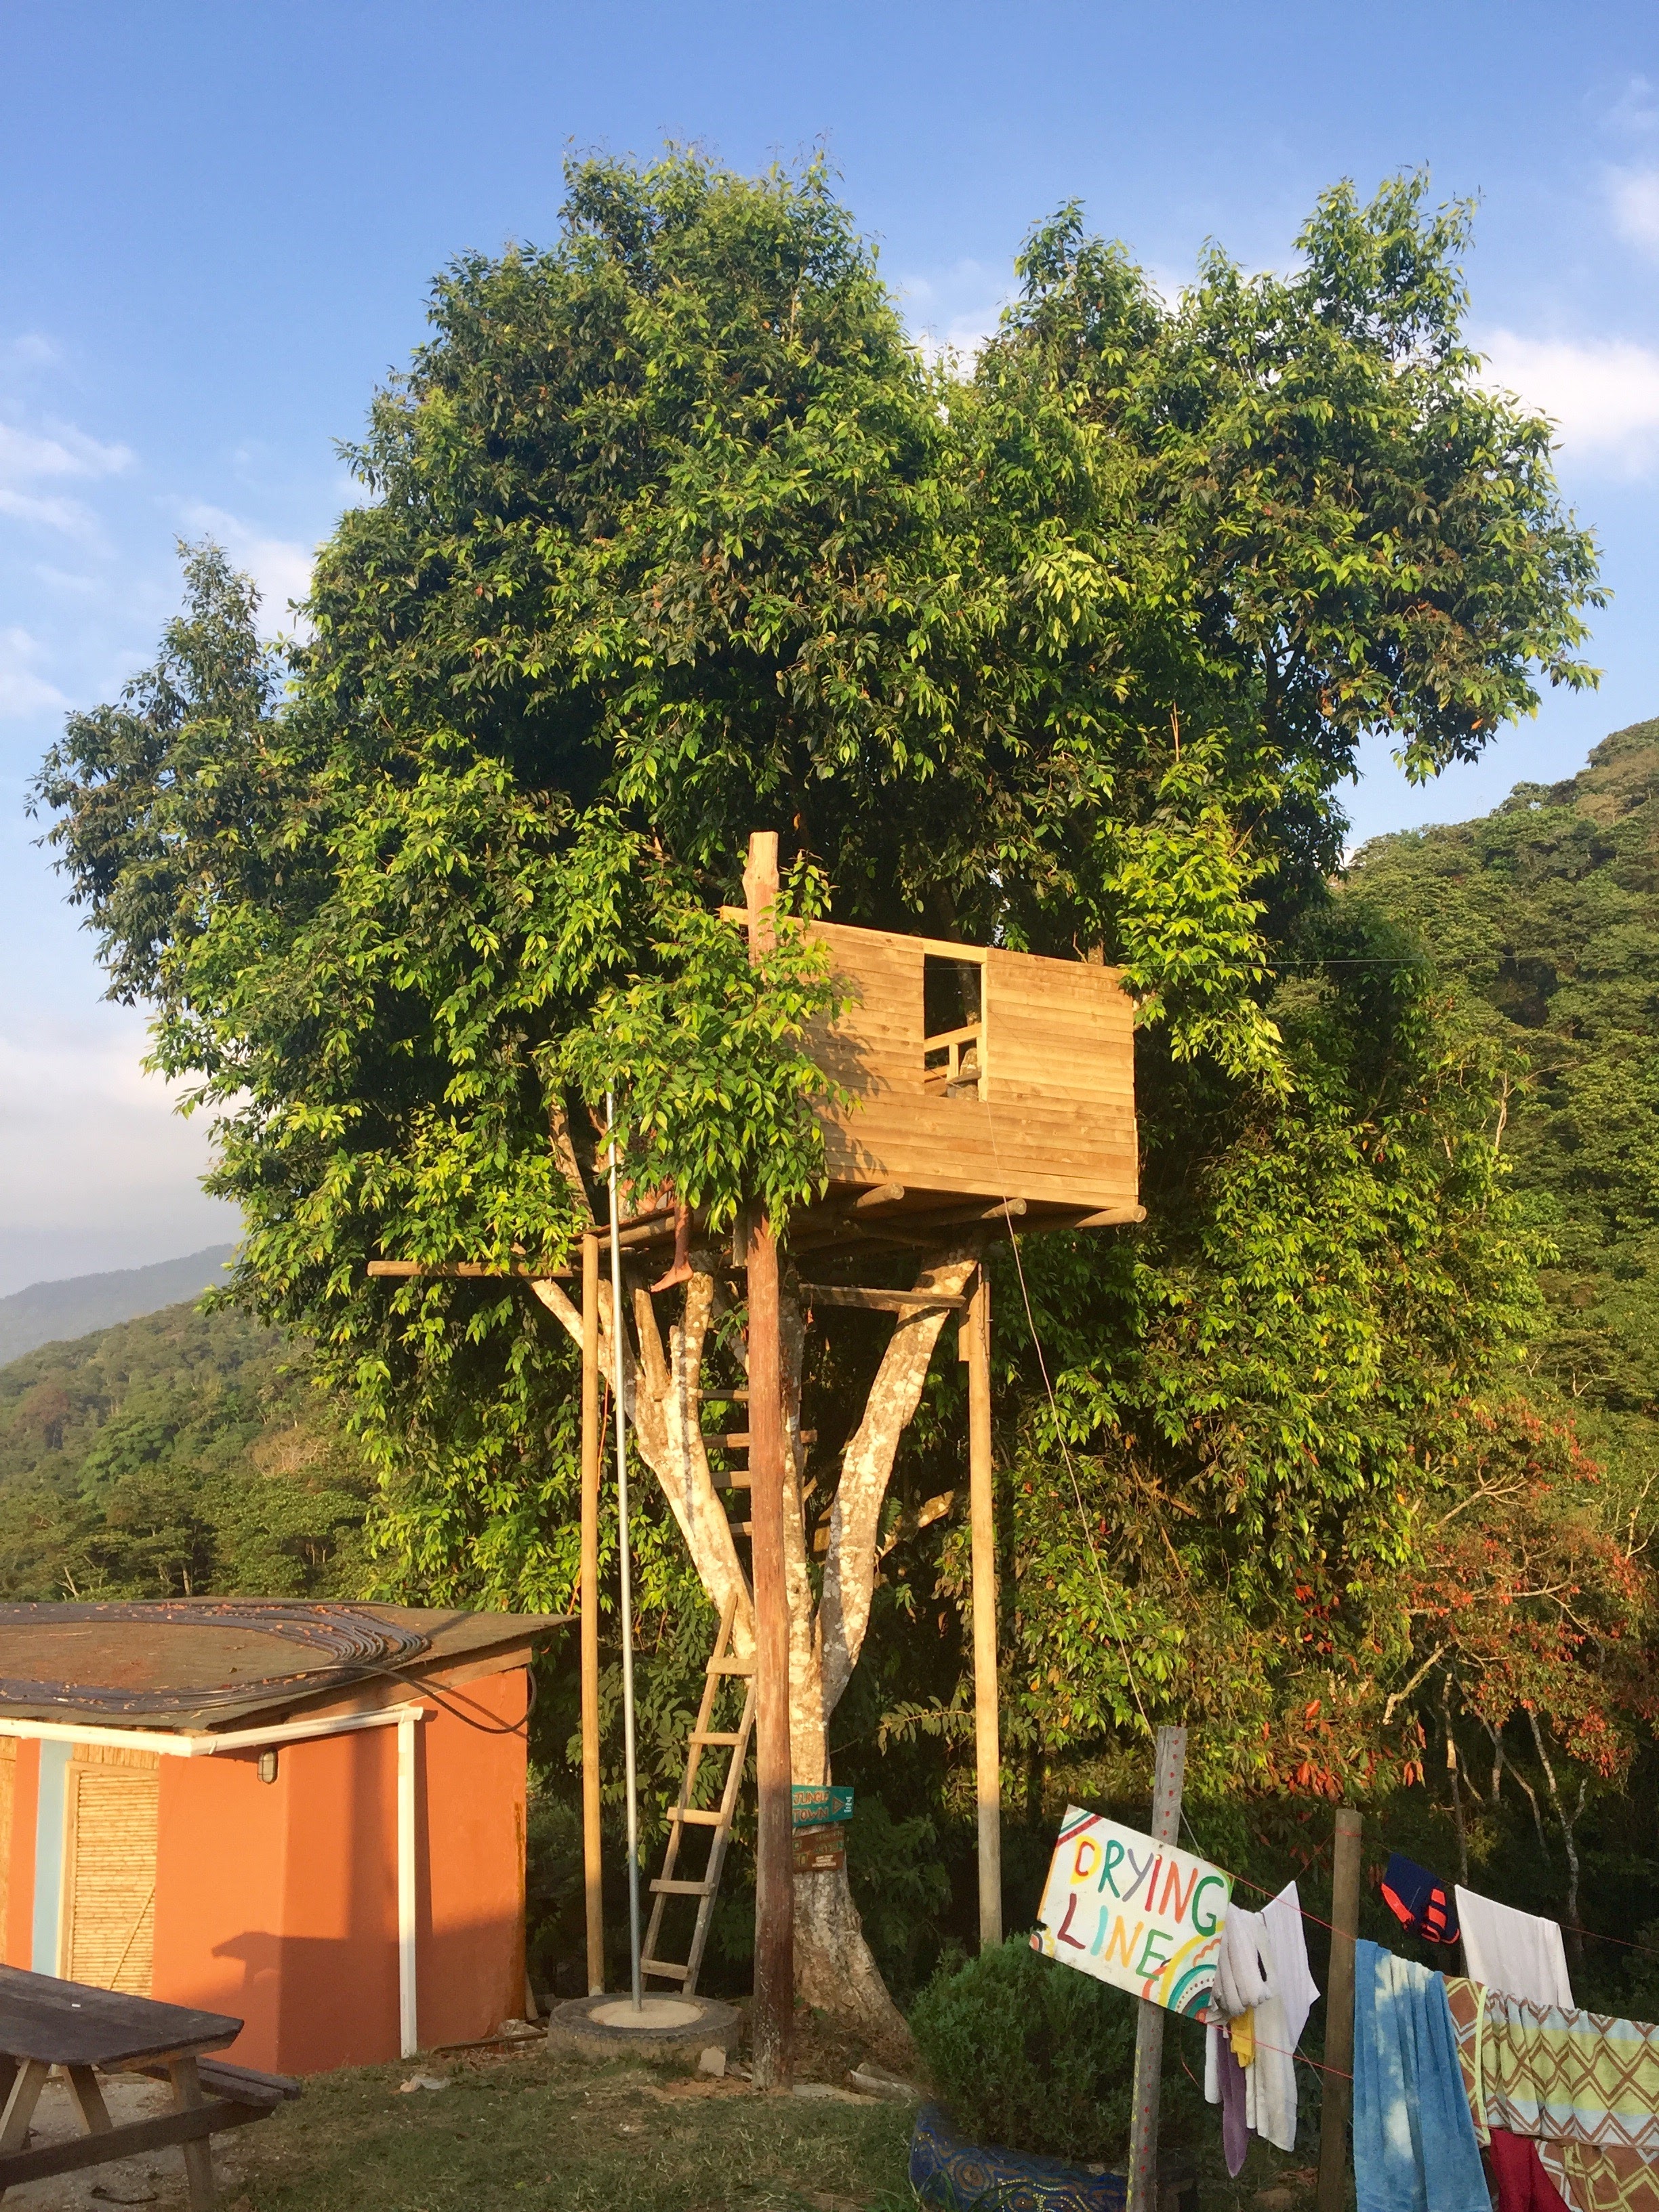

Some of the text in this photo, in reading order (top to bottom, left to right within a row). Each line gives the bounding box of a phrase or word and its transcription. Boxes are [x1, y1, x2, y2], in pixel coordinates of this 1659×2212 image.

[793, 1790, 830, 1805] JUNGLE
[793, 1807, 829, 1823] TOWN
[1070, 1835, 1225, 1937] DRYING
[1057, 1893, 1174, 1981] LINE
